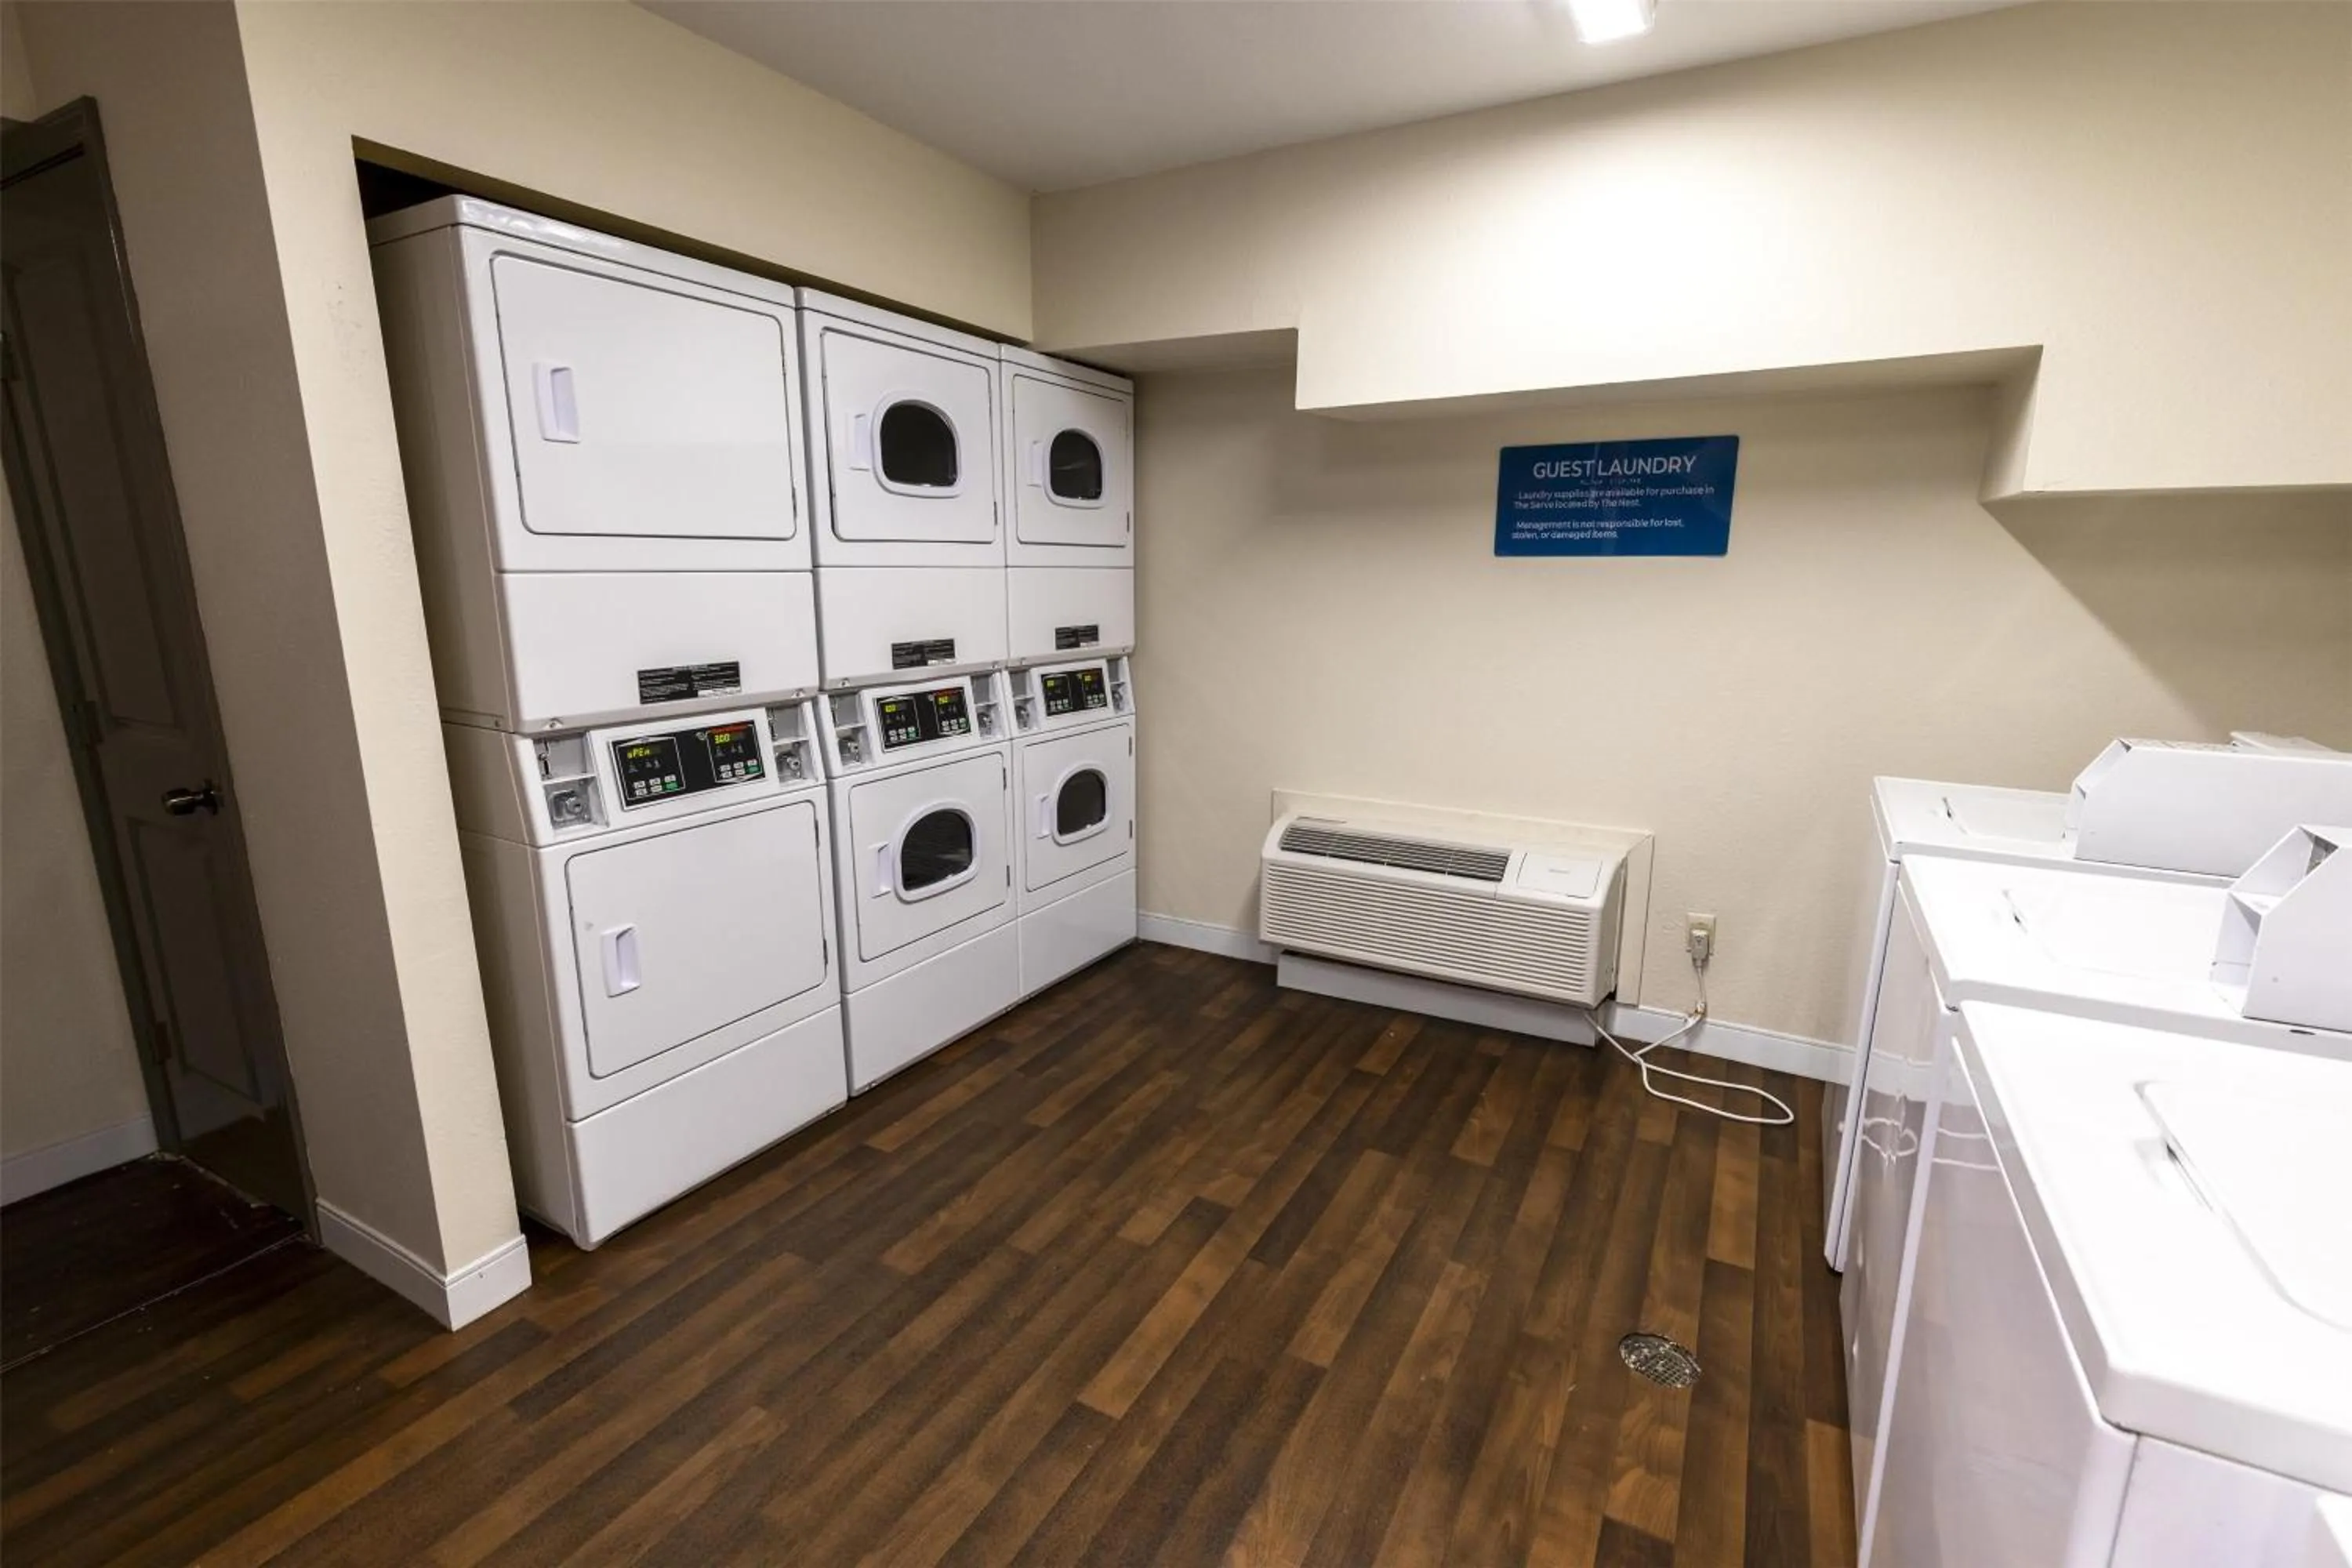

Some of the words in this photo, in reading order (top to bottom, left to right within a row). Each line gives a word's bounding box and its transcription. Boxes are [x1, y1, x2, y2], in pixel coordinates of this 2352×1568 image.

[1533, 459, 1595, 478] GUEST
[1598, 455, 1697, 477] LAUNDRY
[1519, 489, 1552, 501] Laundry
[1554, 488, 1589, 499] supplies
[1605, 486, 1645, 497] available
[1646, 486, 1659, 496] for
[1660, 484, 1704, 498] purchase
[1704, 483, 1715, 495] in
[1514, 500, 1529, 510] The
[1555, 499, 1588, 509] located
[1588, 498, 1600, 510] by
[1516, 520, 1571, 531] Management
[1580, 519, 1595, 528] not
[1596, 518, 1649, 530] responsible
[1650, 517, 1664, 528] for
[1550, 529, 1591, 540] damaged
